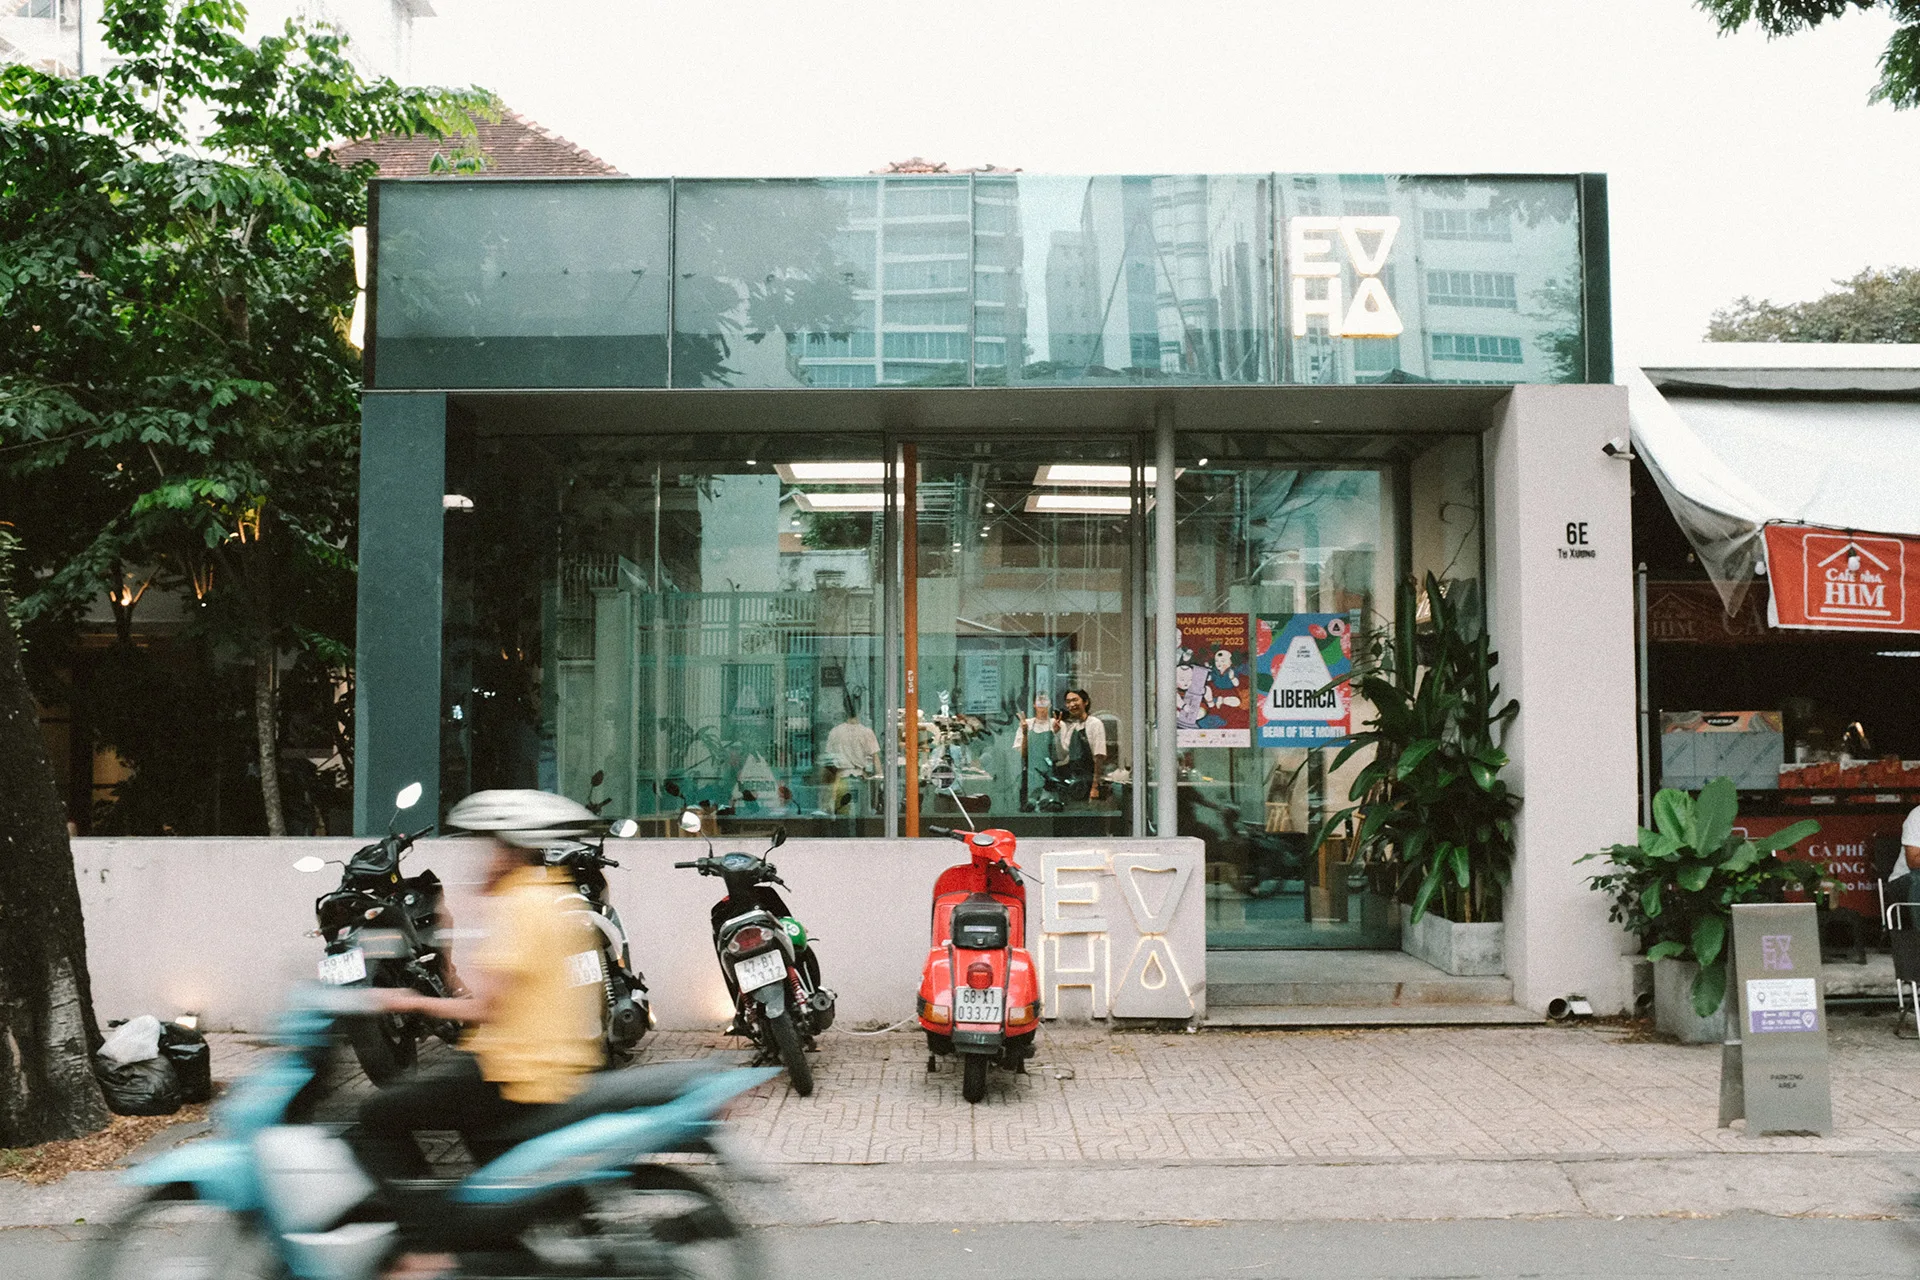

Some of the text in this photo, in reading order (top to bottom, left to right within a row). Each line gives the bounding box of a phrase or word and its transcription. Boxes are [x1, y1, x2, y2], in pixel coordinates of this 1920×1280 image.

[1566, 522, 1588, 545] 6E
[1824, 581, 1886, 607] HIM
[1197, 617, 1244, 625] AEROPRESS
[1183, 627, 1245, 636] CHAMPIONSHIP
[1224, 637, 1245, 646] 2023
[907, 670, 915, 694] PUSH
[1273, 689, 1337, 708] LIBERICA
[1262, 726, 1347, 738] BEAN OF THE MONTH
[958, 1006, 1000, 1021] 033.77
